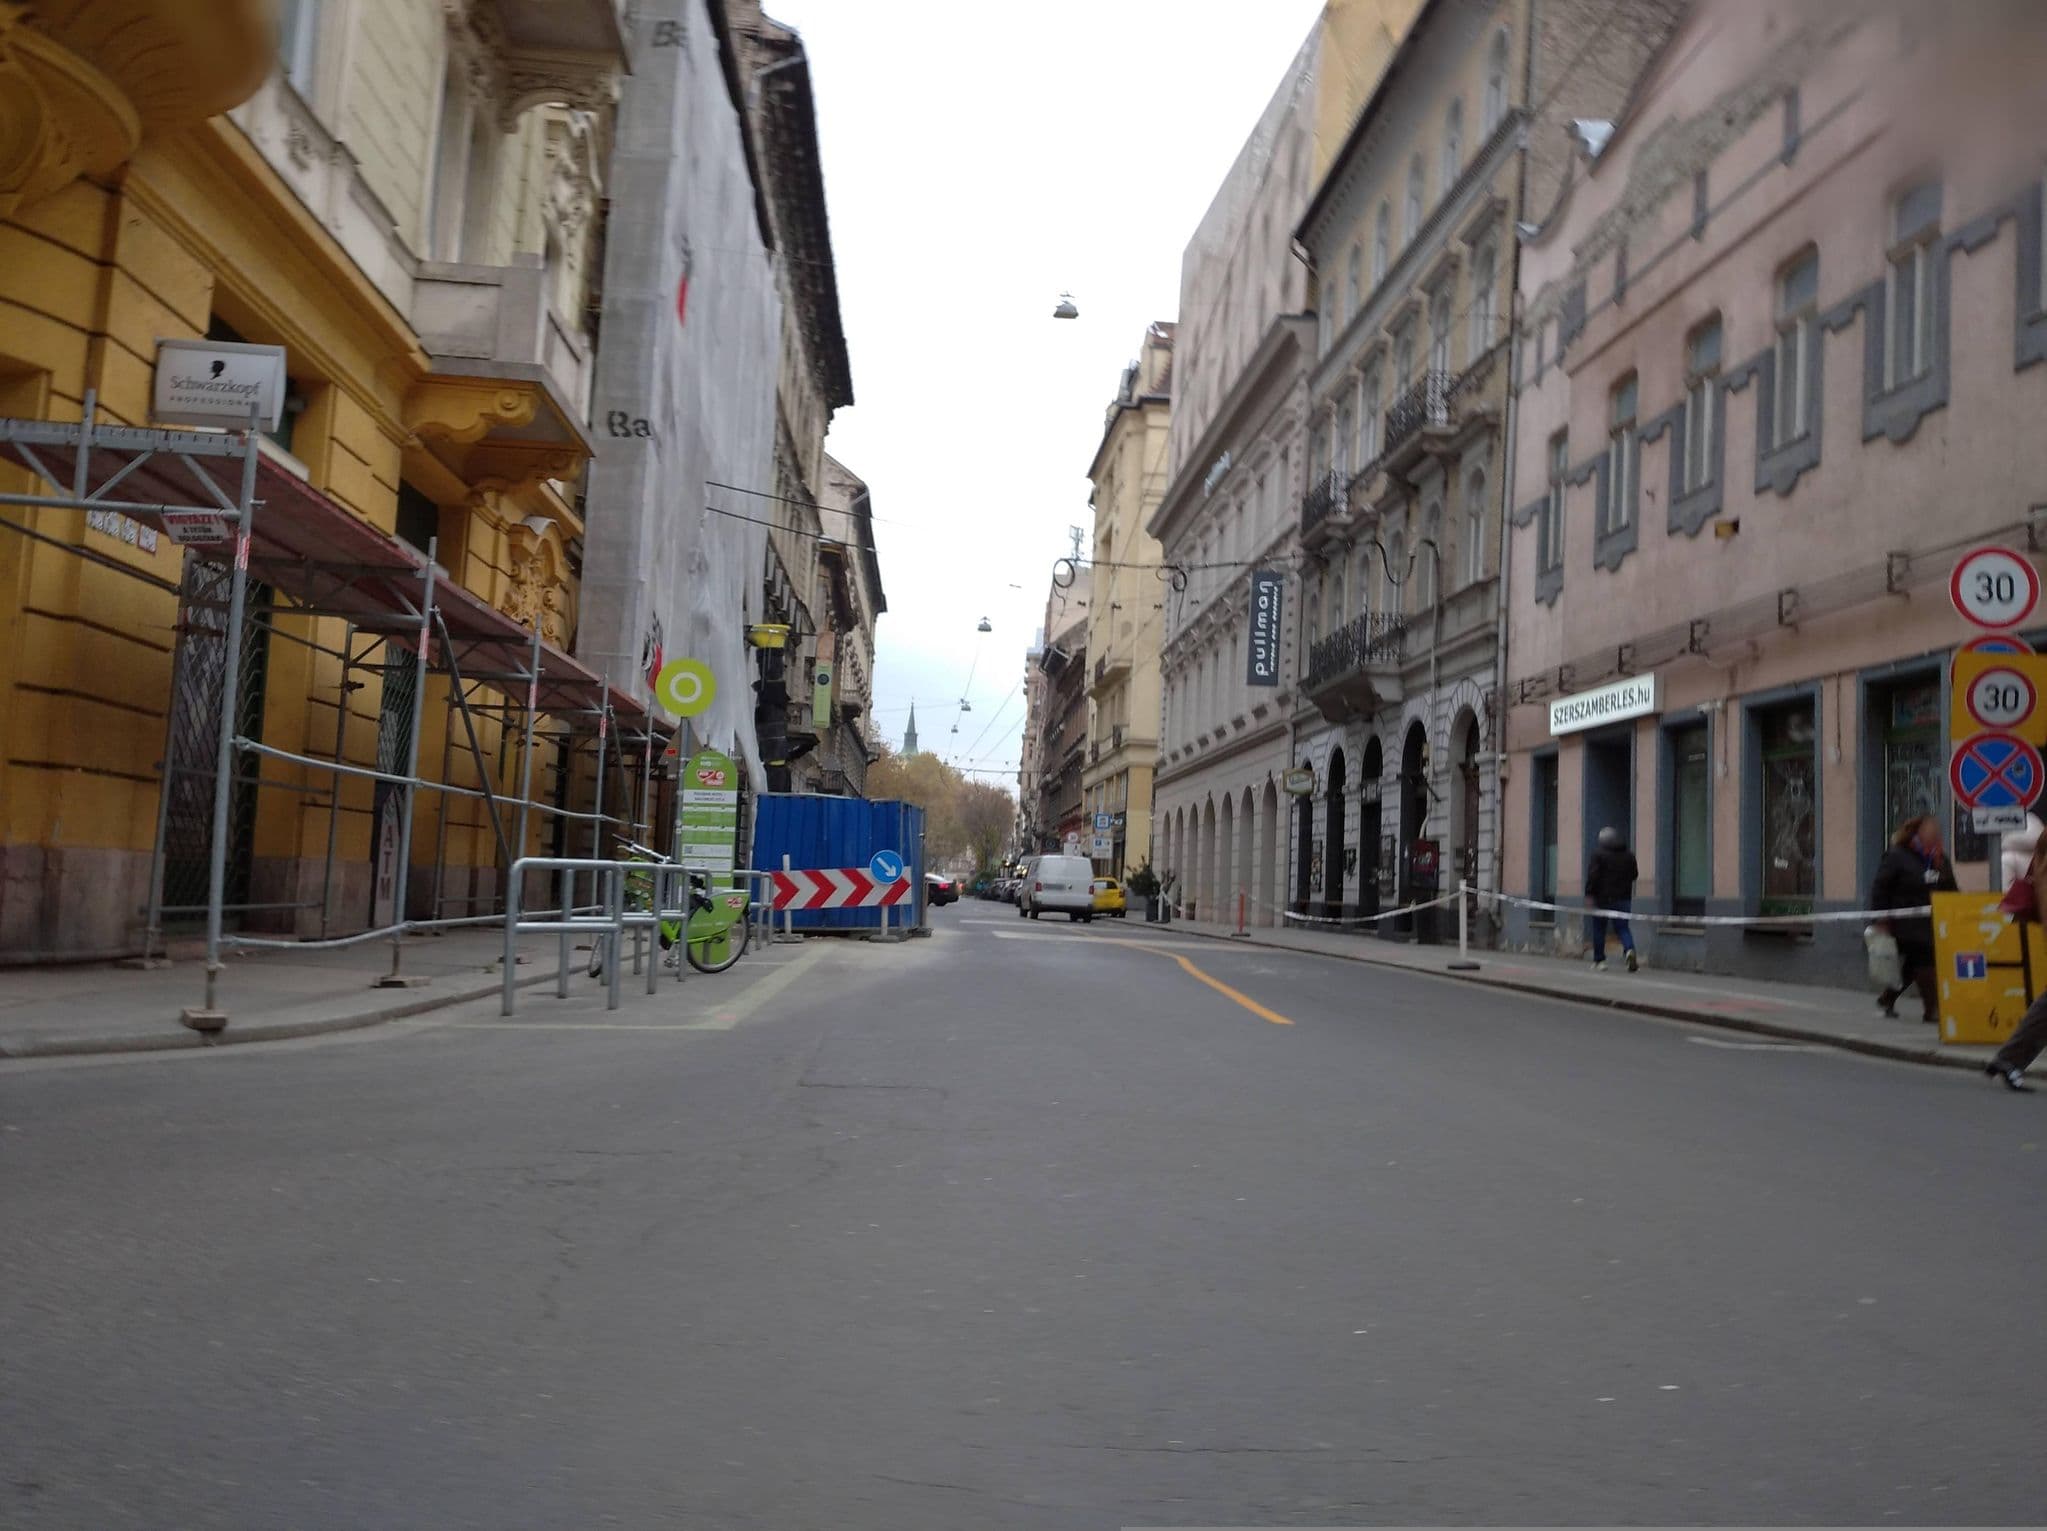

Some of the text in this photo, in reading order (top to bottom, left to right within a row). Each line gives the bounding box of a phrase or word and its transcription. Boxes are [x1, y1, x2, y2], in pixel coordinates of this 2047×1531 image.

[169, 375, 262, 399] Schwarzkopf
[1975, 571, 2015, 604] 30
[1253, 580, 1273, 677] pullman
[1553, 683, 1651, 727] SZERSZAMBERLES.hu
[1983, 684, 2019, 713] 30
[379, 825, 394, 901] ATM
